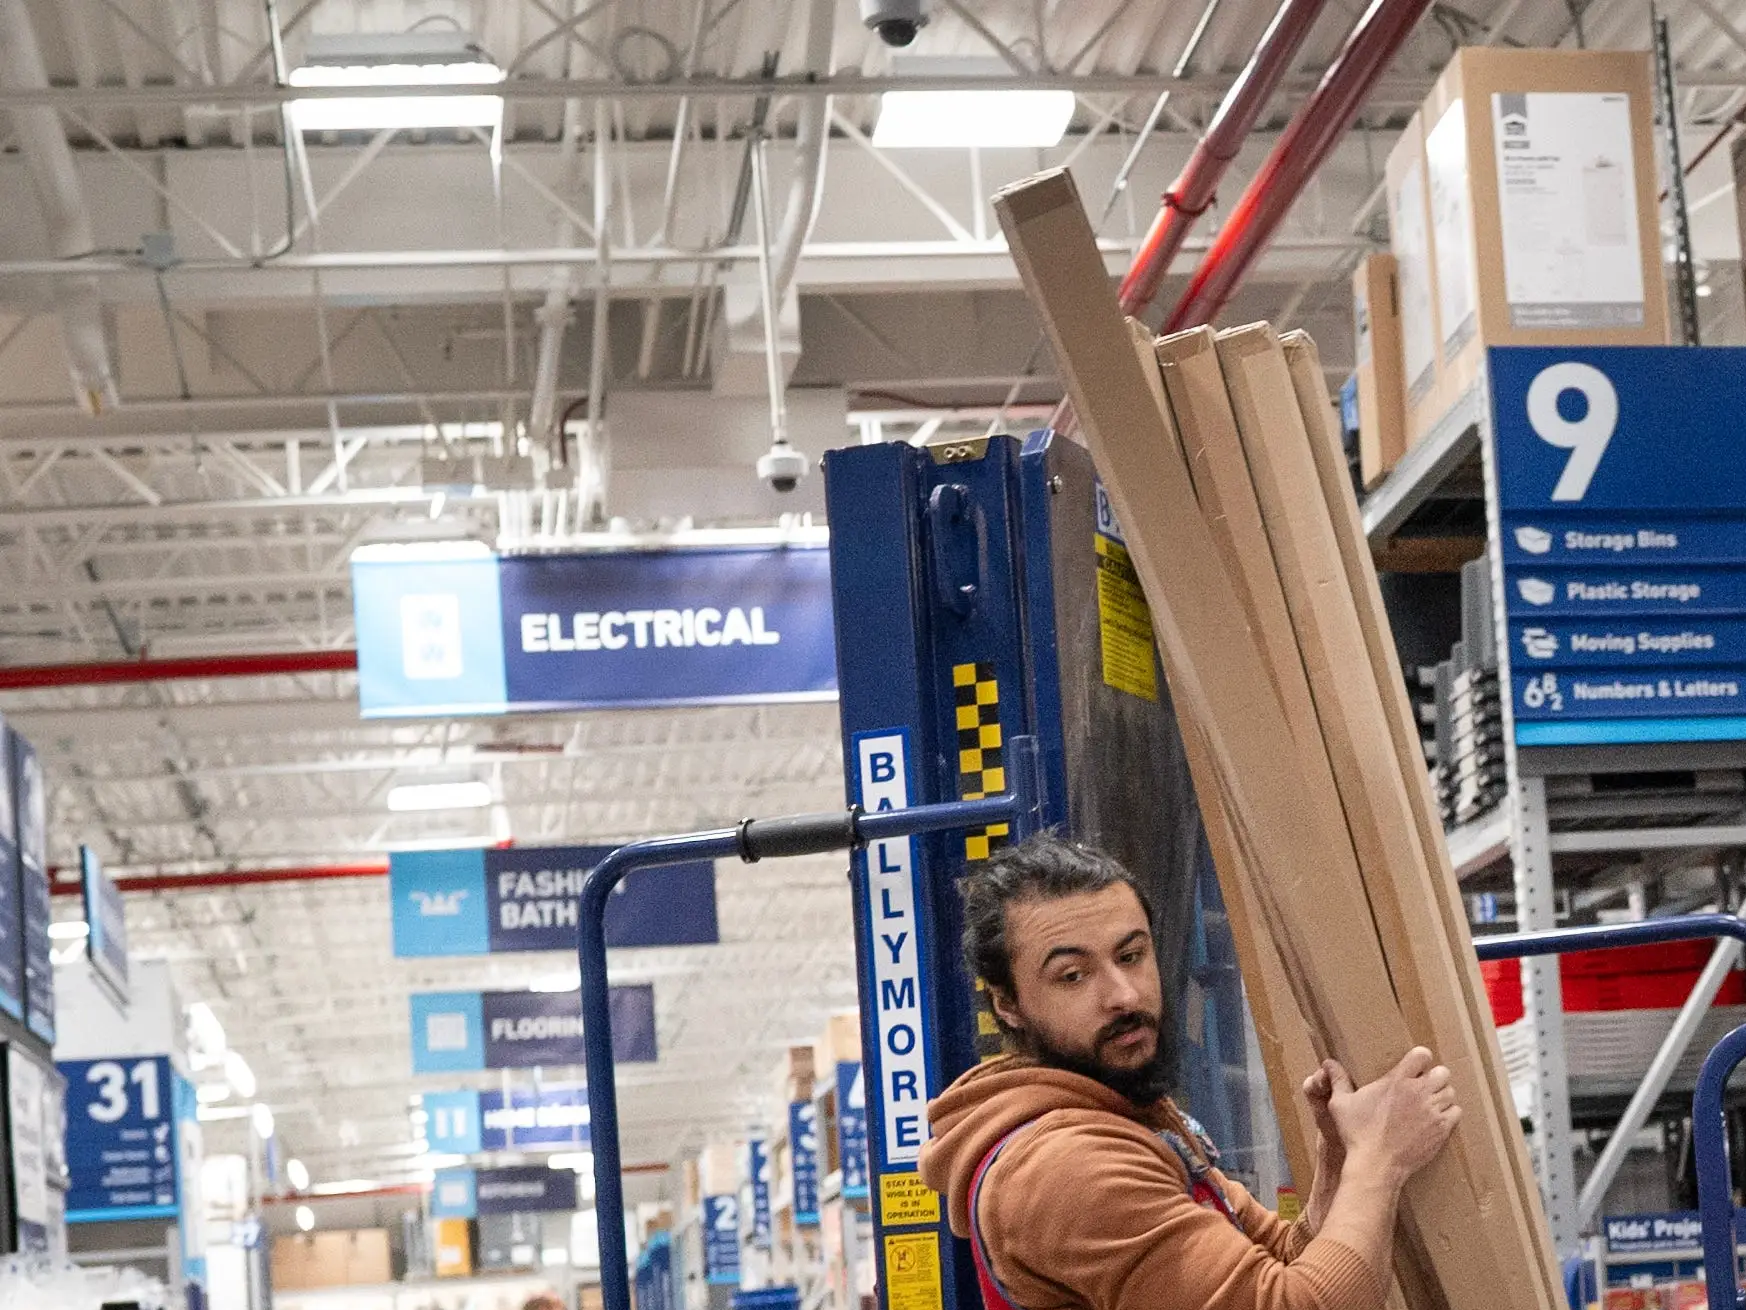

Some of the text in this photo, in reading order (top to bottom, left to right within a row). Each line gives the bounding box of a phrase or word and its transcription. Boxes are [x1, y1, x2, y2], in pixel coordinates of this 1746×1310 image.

[1526, 361, 1619, 502] 9
[1564, 529, 1678, 552] Storage Bins
[1566, 581, 1700, 602] Plastic Storage
[520, 607, 781, 653] ELECTRICAL
[1570, 632, 1715, 654] Moving Supplies
[1573, 680, 1738, 700] Numbers & Letters
[501, 902, 579, 929] BATH
[87, 1061, 160, 1123] 31
[714, 1196, 738, 1232] 2
[886, 1209, 935, 1219] OPERATION
